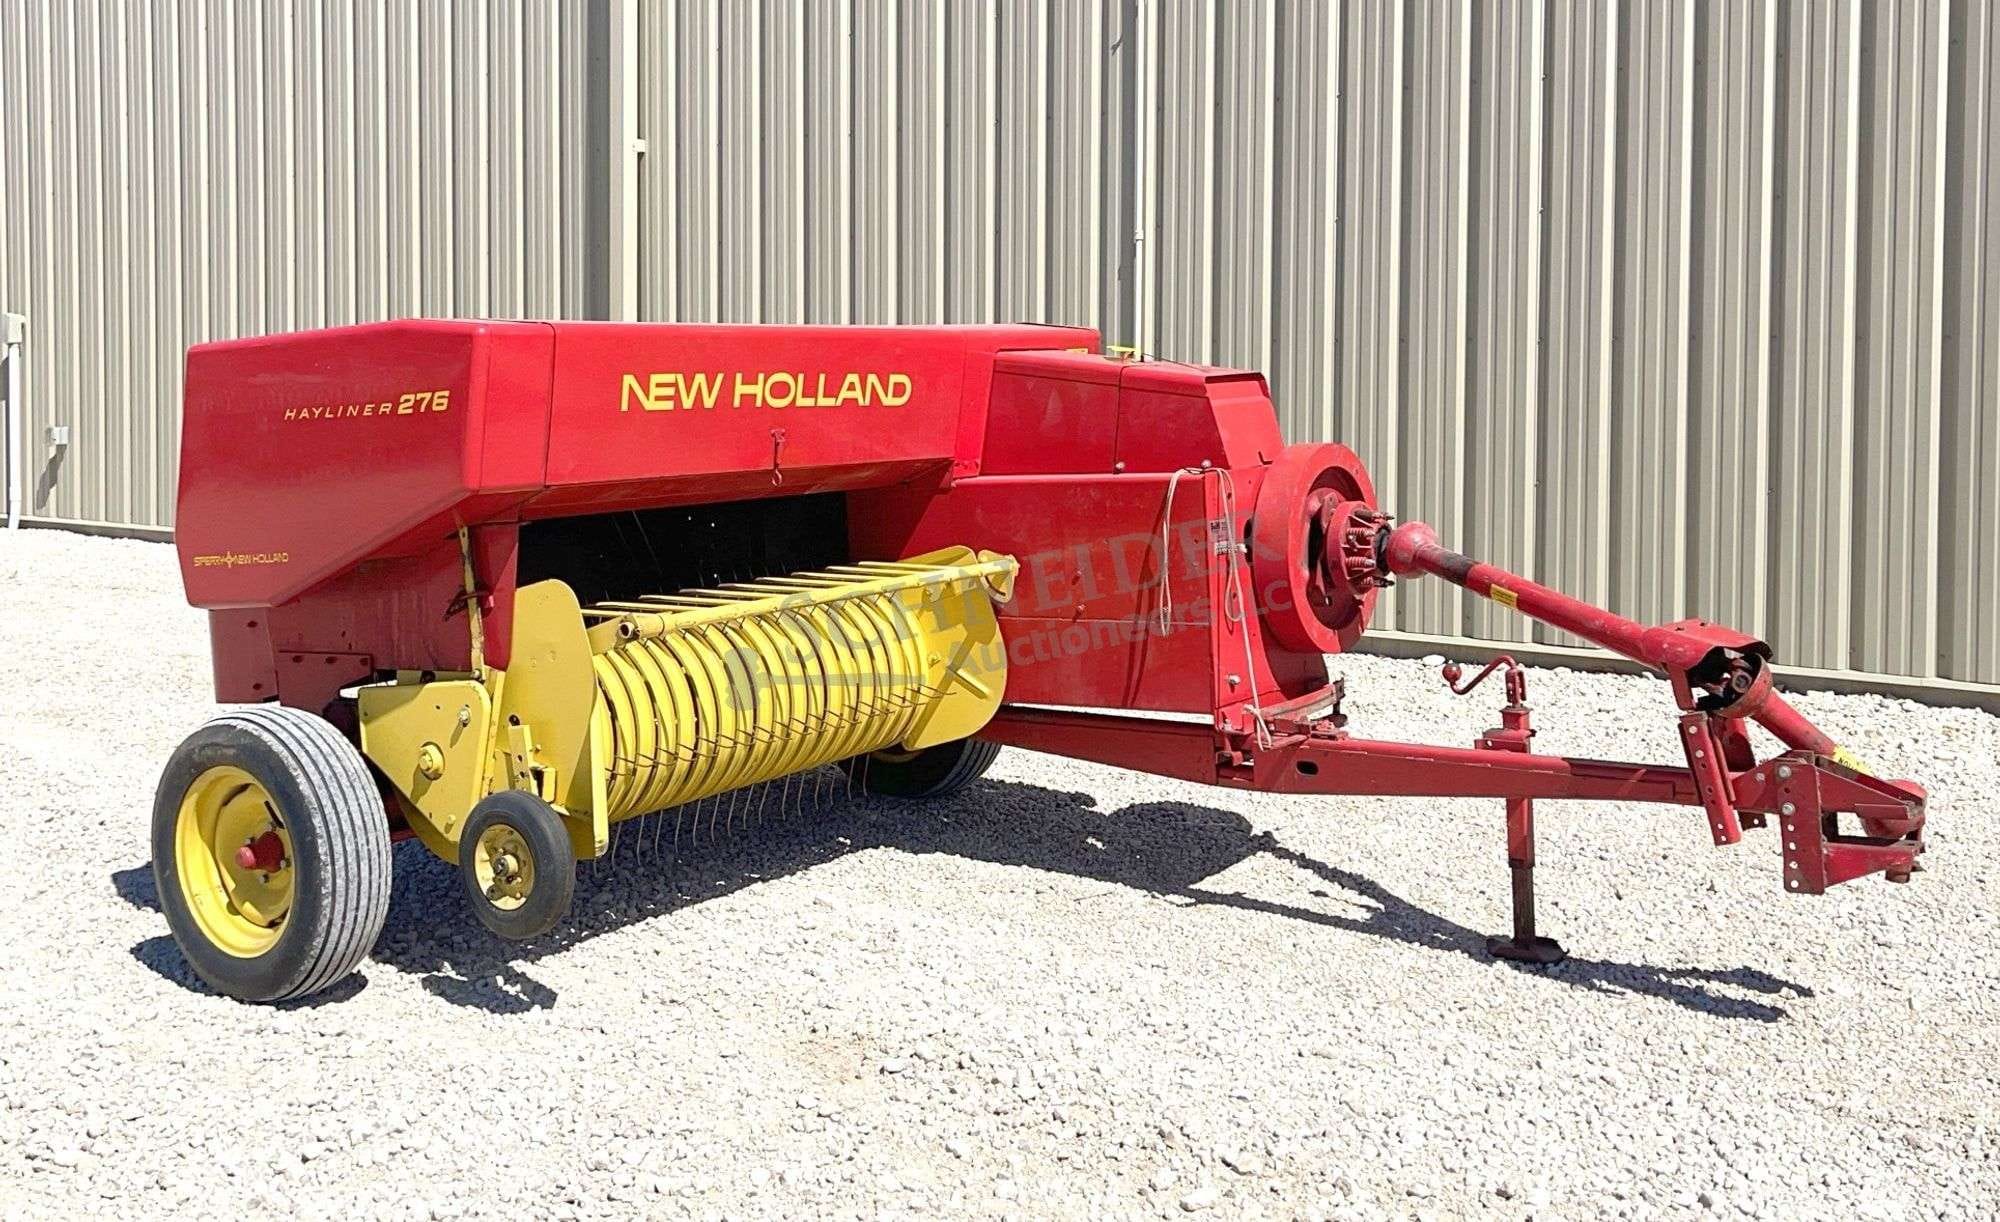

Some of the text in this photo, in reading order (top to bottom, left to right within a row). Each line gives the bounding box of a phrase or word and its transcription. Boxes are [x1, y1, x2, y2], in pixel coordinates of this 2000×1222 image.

[284, 390, 450, 421] HAYLINER 276
[620, 372, 912, 412] NEW HOLLAND
[253, 552, 289, 564] HOLLAND
